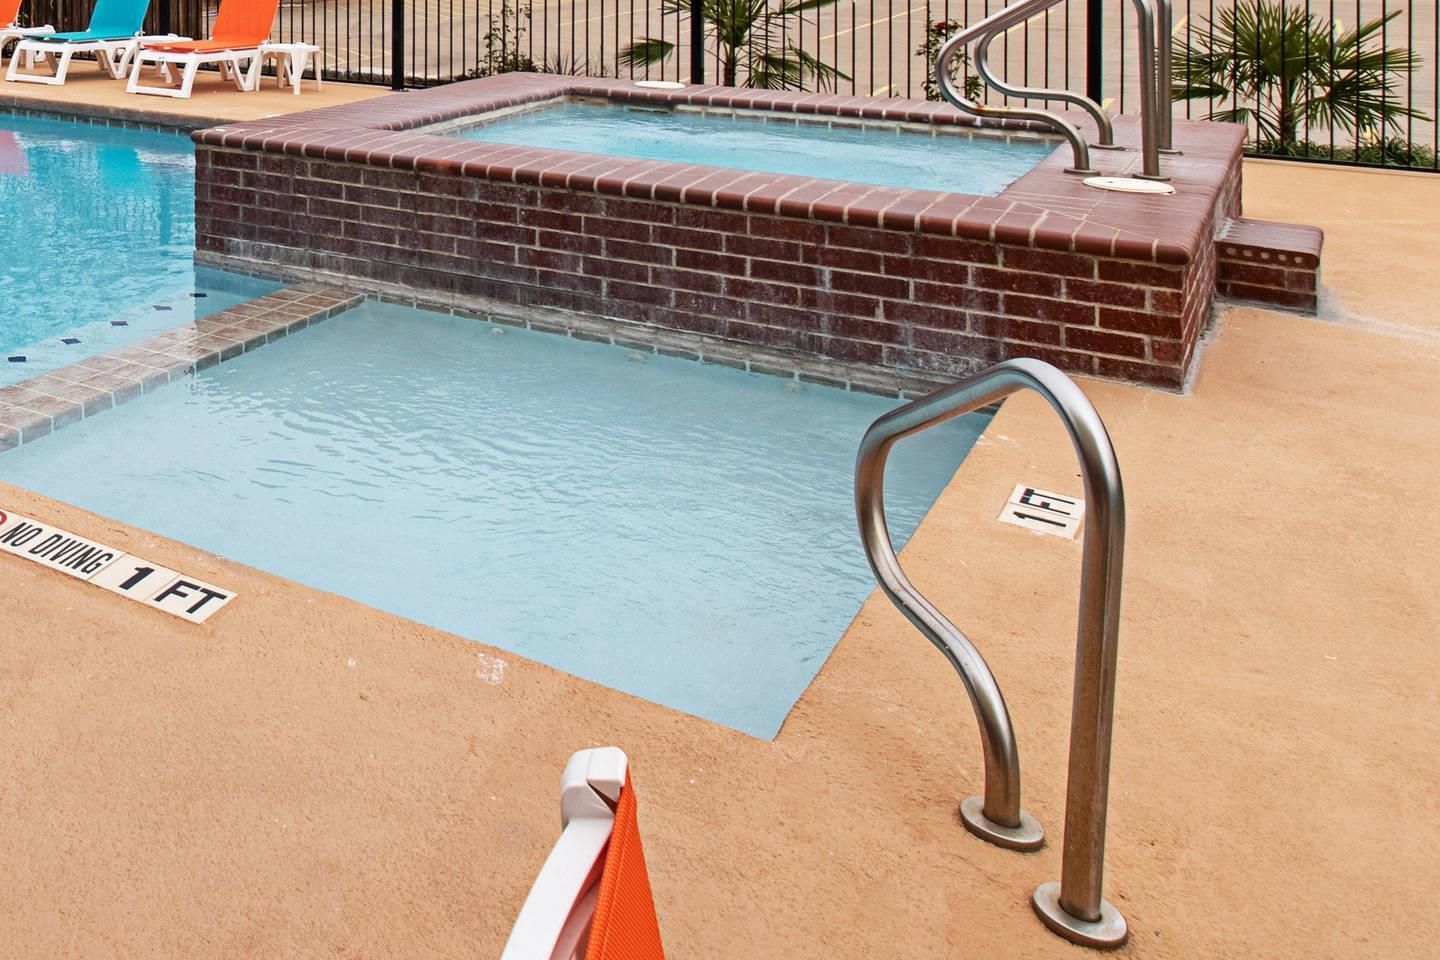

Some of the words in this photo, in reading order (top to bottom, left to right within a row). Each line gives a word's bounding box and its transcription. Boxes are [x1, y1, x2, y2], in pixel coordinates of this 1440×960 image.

[1019, 488, 1075, 516] FT
[28, 534, 114, 574] DIVING
[118, 566, 155, 590] 1
[153, 580, 228, 614] FT
